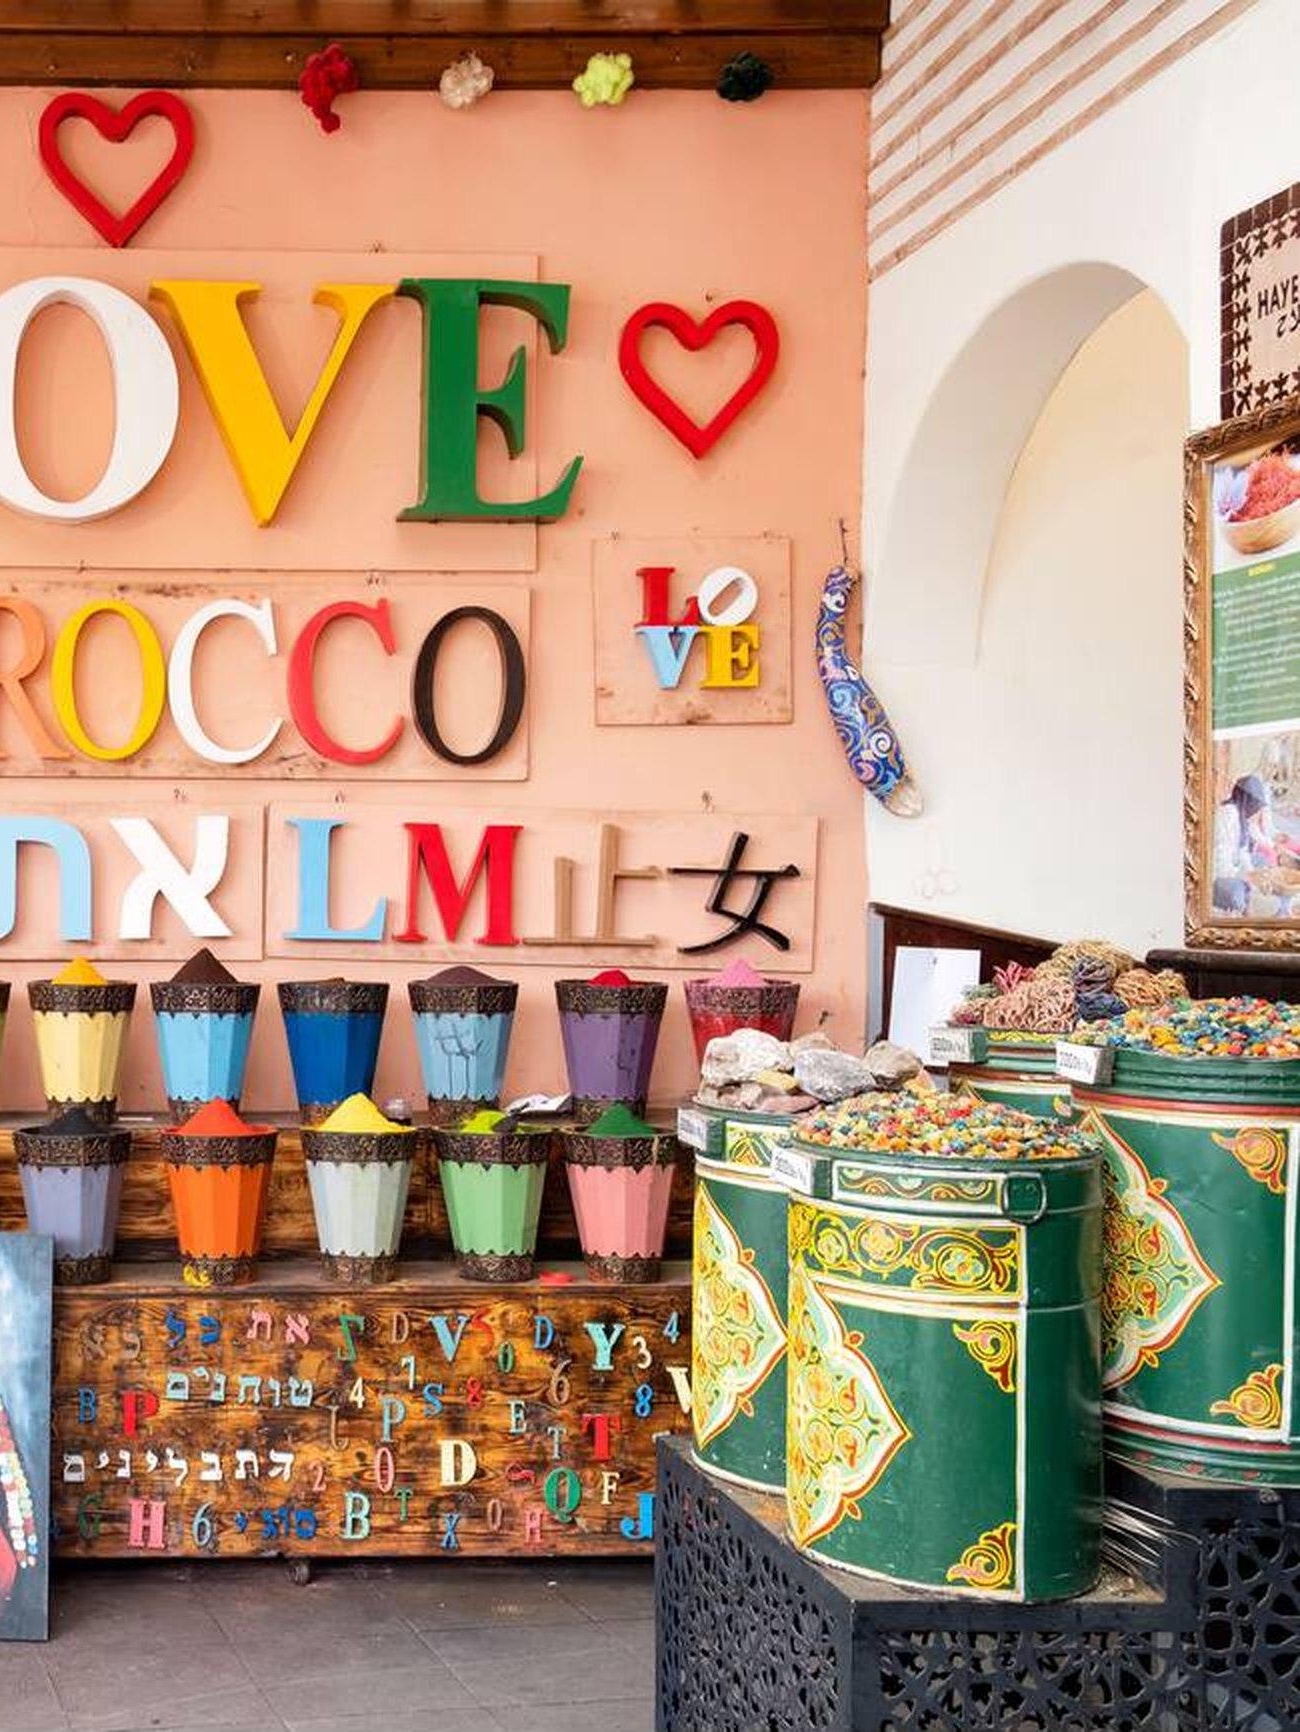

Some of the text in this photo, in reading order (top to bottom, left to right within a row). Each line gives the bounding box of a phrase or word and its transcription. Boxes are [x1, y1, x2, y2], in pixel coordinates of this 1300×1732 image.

[583, 1322, 627, 1371] Y
[437, 1438, 477, 1486] D
[543, 1467, 582, 1524] Q
